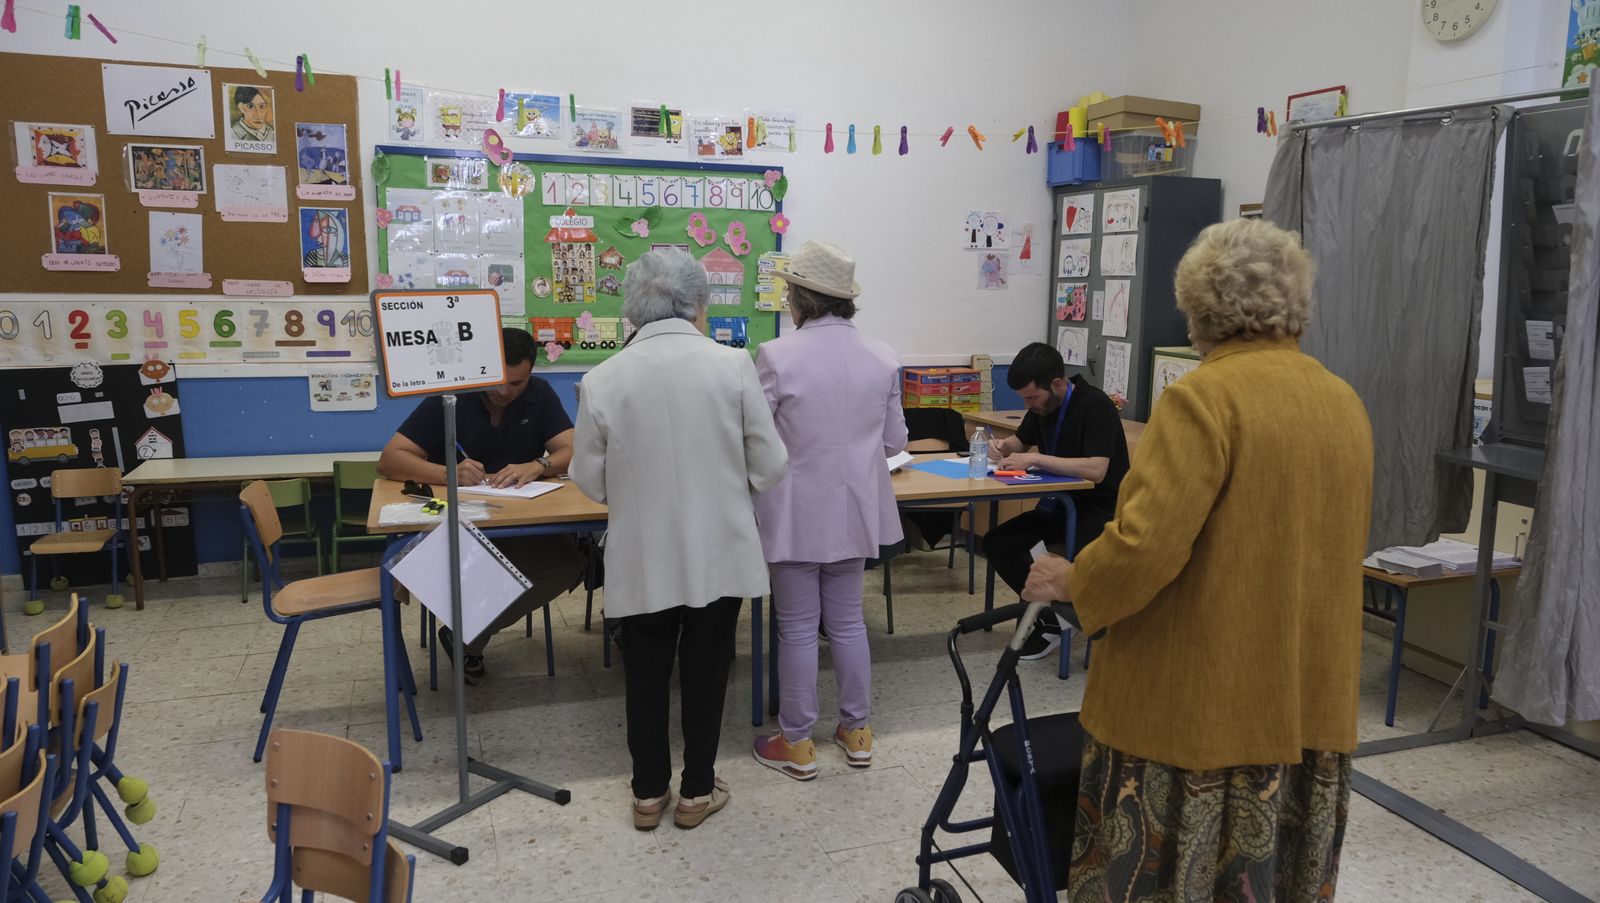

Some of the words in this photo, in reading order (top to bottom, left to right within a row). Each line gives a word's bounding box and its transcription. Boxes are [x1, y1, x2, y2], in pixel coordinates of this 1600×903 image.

[1474, 2, 1480, 10] 4
[1432, 12, 1439, 22] 8
[1464, 14, 1471, 24] 5
[1440, 20, 1446, 30] 7
[1452, 22, 1458, 30] 6
[124, 76, 197, 130] Picasso
[234, 142, 273, 150] PICASSO
[547, 181, 556, 204] 1
[571, 182, 586, 205] 2
[618, 183, 633, 206] 4
[642, 183, 656, 206] 5
[664, 184, 678, 206] 6
[684, 185, 699, 207] 7
[709, 185, 724, 207] 8
[730, 187, 744, 209] 9
[750, 188, 774, 210] 10
[555, 218, 588, 226] COLEGIO
[382, 300, 424, 310] SECCIÓN
[446, 296, 460, 309] 3ª
[33, 310, 52, 340] 1
[68, 310, 92, 340] 2
[106, 310, 128, 339] 3
[144, 310, 164, 339] 4
[178, 310, 200, 338] 5
[214, 309, 236, 338] 6
[249, 309, 269, 338] 7
[284, 309, 305, 338] 8
[317, 309, 336, 338] 9
[340, 309, 374, 338] 10
[386, 329, 438, 347] MESA
[457, 322, 474, 342] B
[436, 370, 445, 380] M
[480, 366, 487, 375] Z
[143, 447, 149, 457] 2
